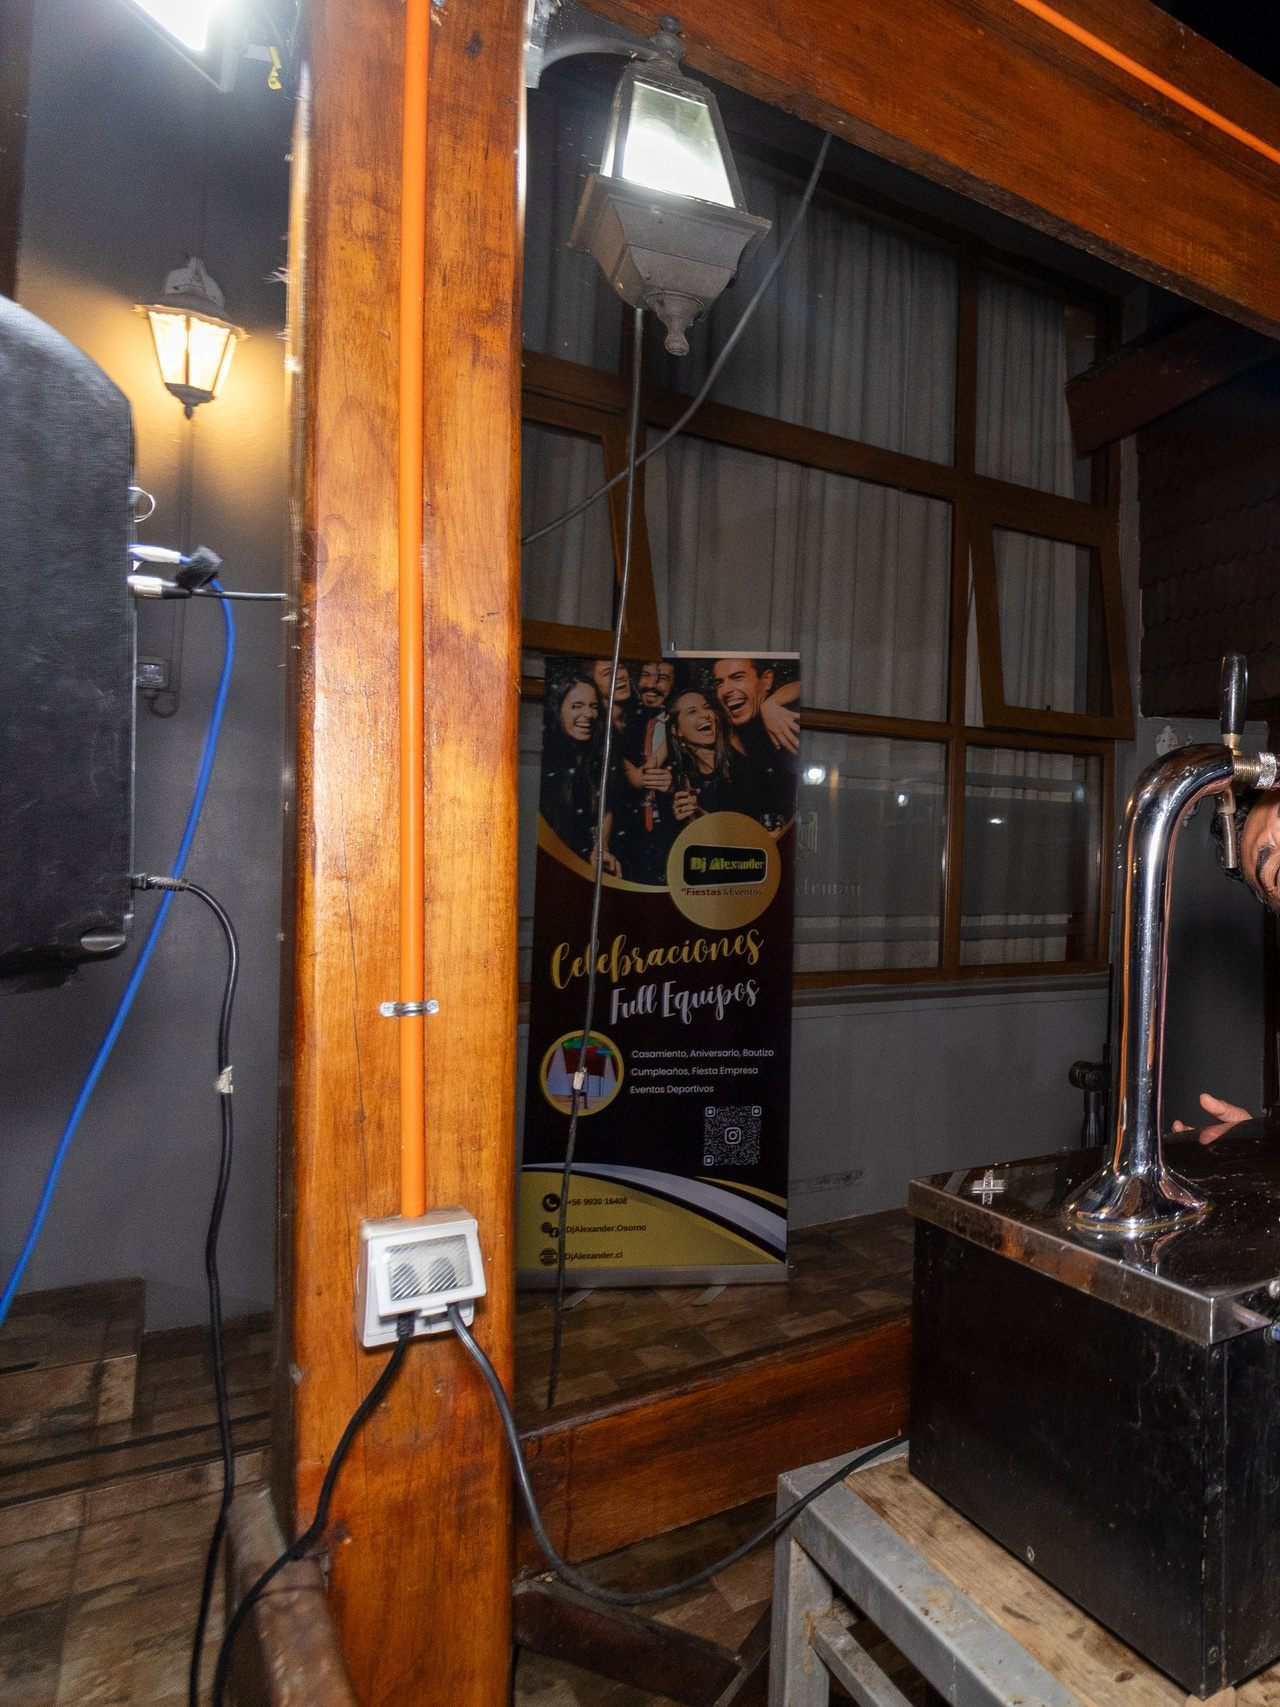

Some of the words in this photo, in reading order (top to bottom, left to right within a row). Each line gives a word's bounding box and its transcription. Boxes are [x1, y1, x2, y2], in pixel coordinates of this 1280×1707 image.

[690, 857, 707, 873] Dj
[709, 857, 765, 870] Alexander
[551, 928, 764, 990] Celebraciones
[609, 982, 657, 1026] Full
[661, 978, 760, 1025] Equipos
[631, 1049, 689, 1059] Casamiento,
[690, 1048, 742, 1058] Aniversario,
[742, 1048, 774, 1057] Bautizo
[630, 1066, 691, 1077] Cumpleaños,
[692, 1066, 718, 1075] Fiesta
[720, 1065, 759, 1076] Empresa
[630, 1085, 665, 1094] Eventos
[667, 1084, 714, 1095] Deportivos
[566, 1224, 647, 1234] DjAlexander.Osorno
